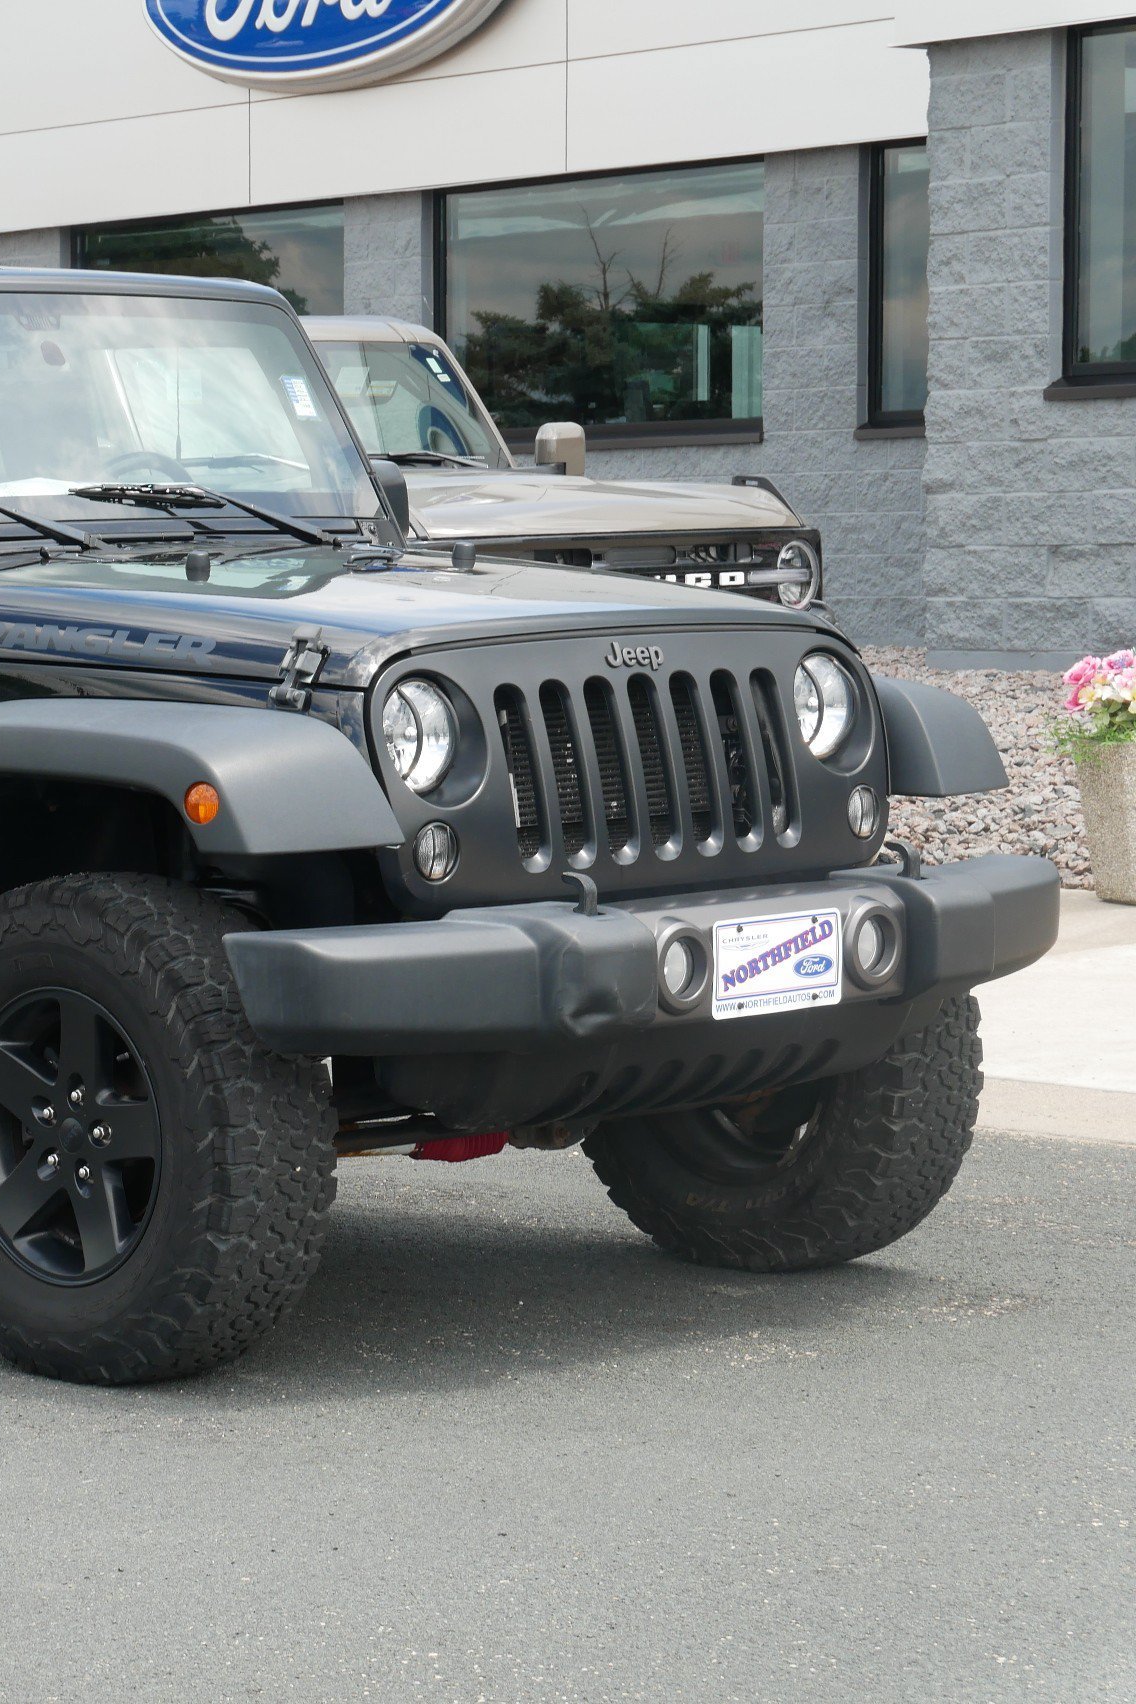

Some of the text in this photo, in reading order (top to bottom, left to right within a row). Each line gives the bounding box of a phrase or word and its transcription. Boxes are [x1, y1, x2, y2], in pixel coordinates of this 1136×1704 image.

[605, 641, 664, 671] Jeep
[722, 933, 769, 945] CHRYSLER
[721, 919, 834, 993] NORTHFIELD
[800, 957, 826, 974] Ford
[715, 989, 835, 1013] WWW.NORTHFIELDAUTOSCOM
